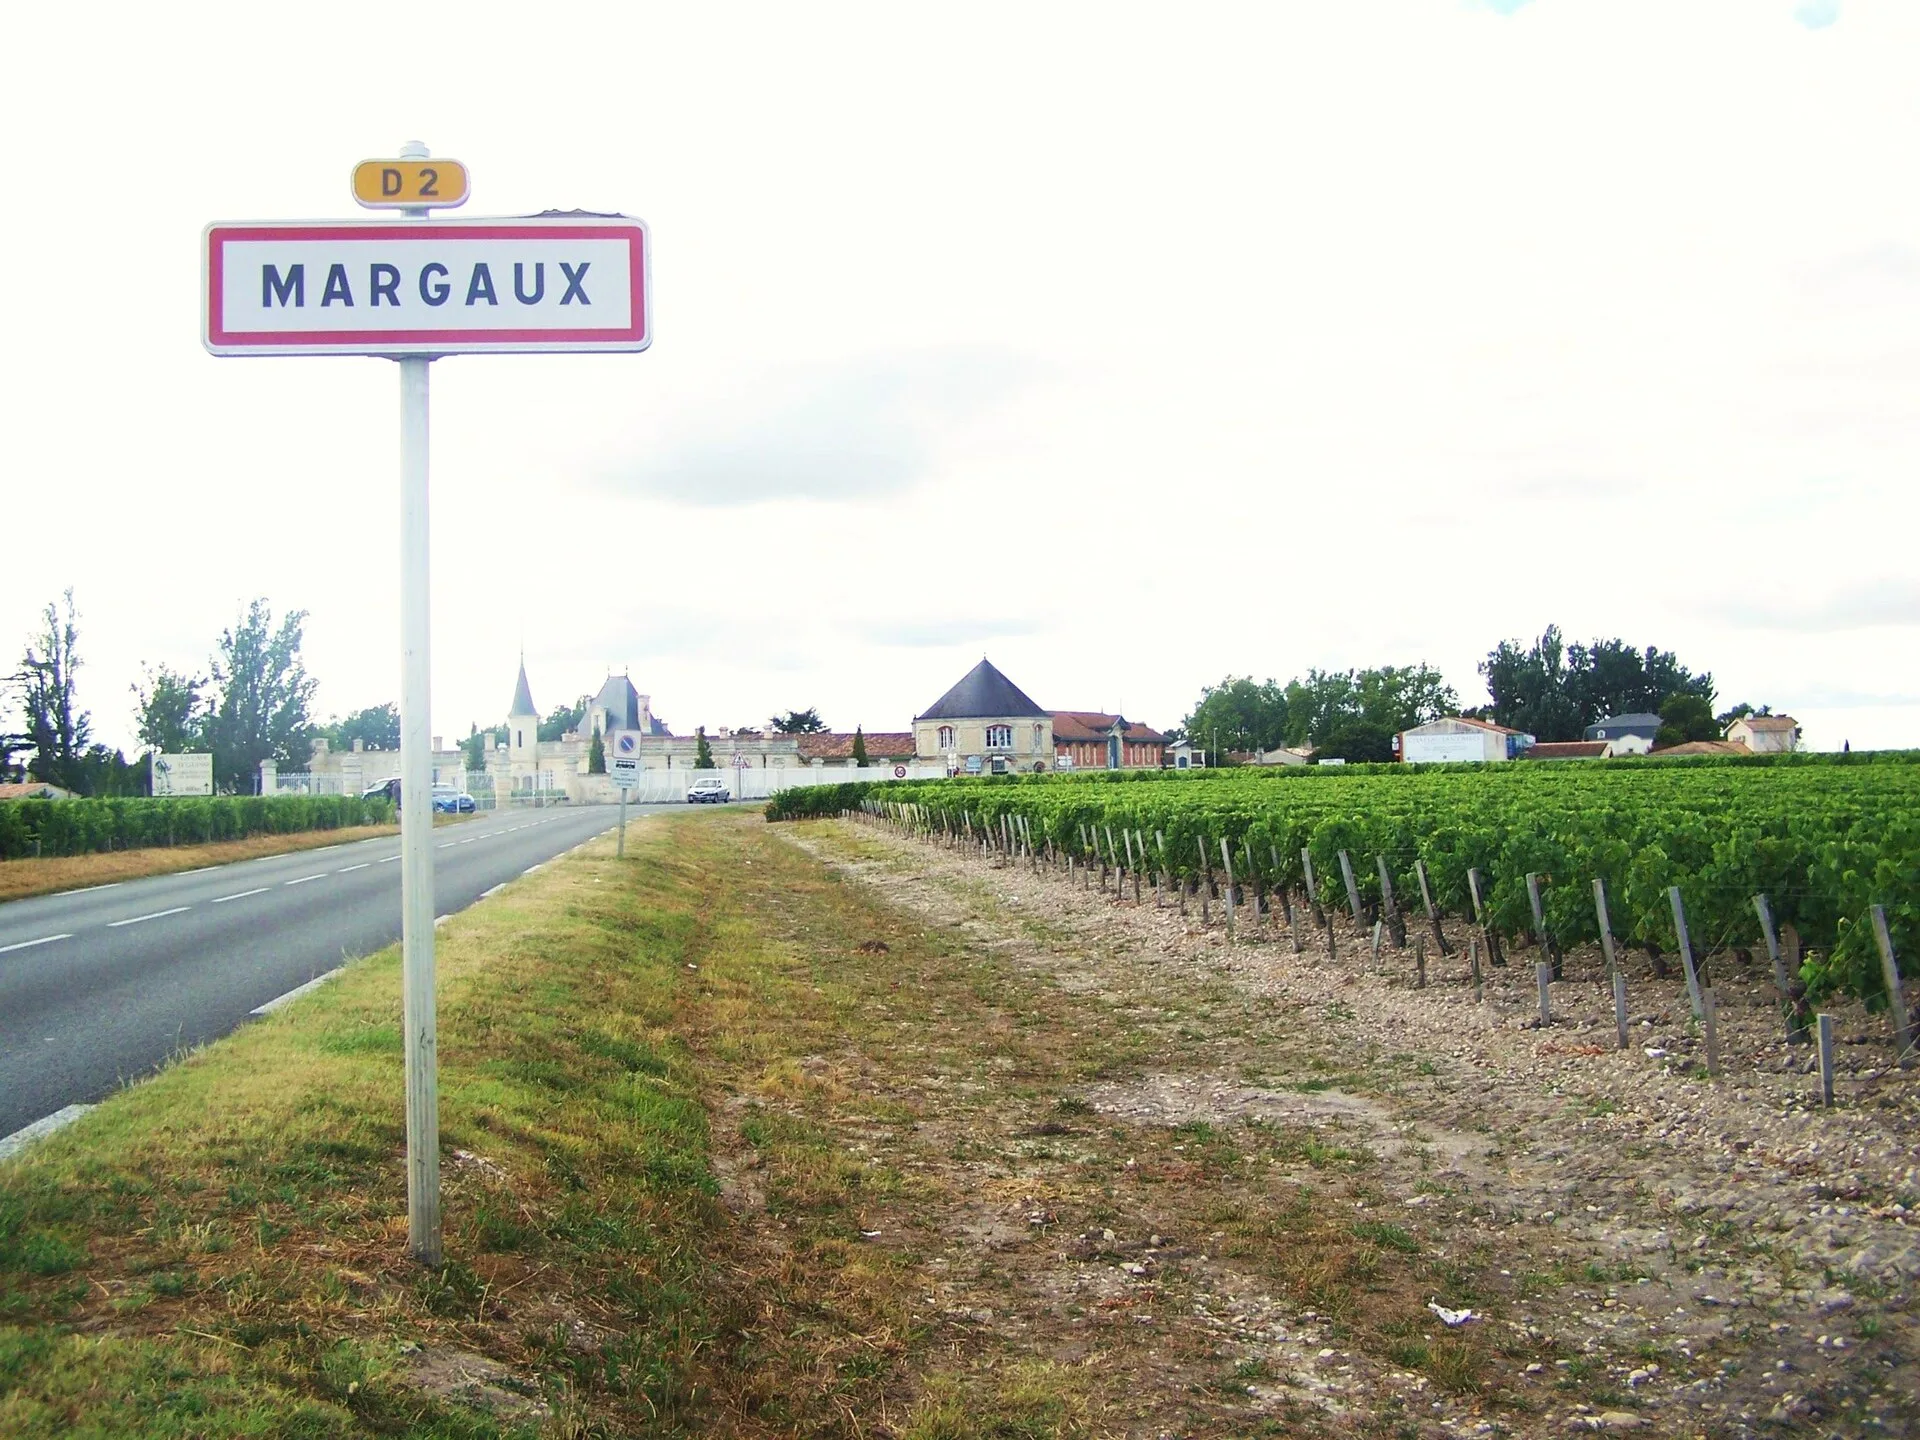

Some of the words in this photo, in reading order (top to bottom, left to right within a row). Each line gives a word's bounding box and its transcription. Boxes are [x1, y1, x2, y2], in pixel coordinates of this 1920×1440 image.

[382, 168, 403, 196] D
[418, 168, 439, 196] 2
[261, 262, 592, 308] MARGAUX
